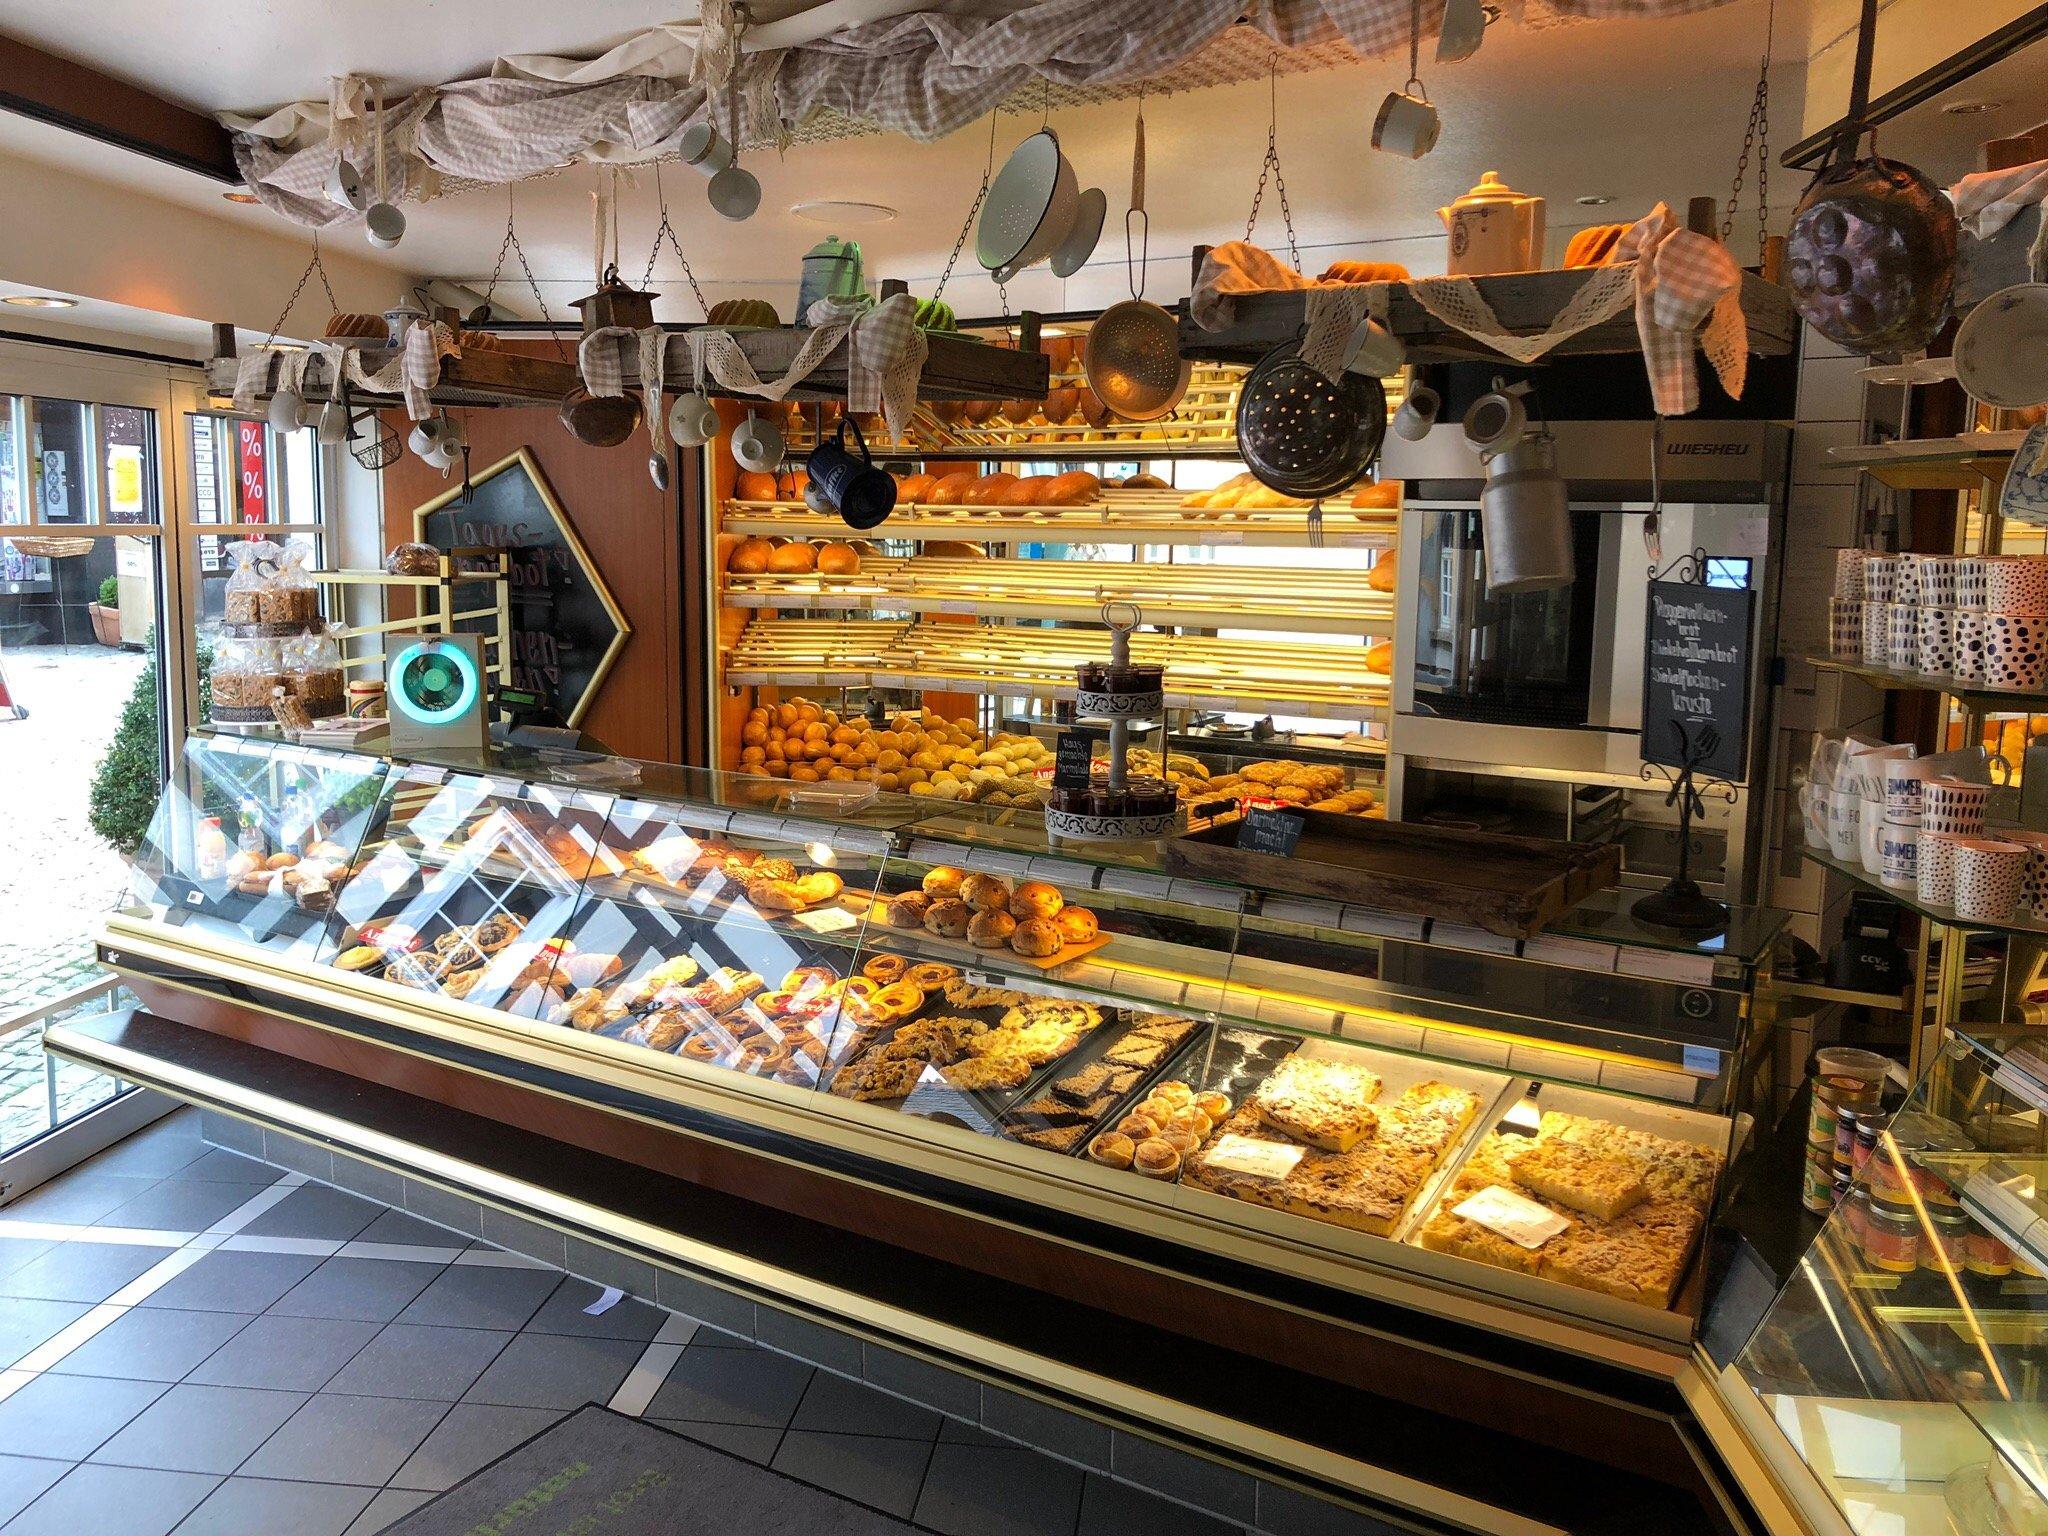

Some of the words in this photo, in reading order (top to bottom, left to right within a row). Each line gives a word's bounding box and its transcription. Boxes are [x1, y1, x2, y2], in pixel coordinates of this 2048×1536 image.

[242, 428, 261, 457] %
[1666, 443, 1750, 456] WIESHEU
[244, 471, 263, 499] %
